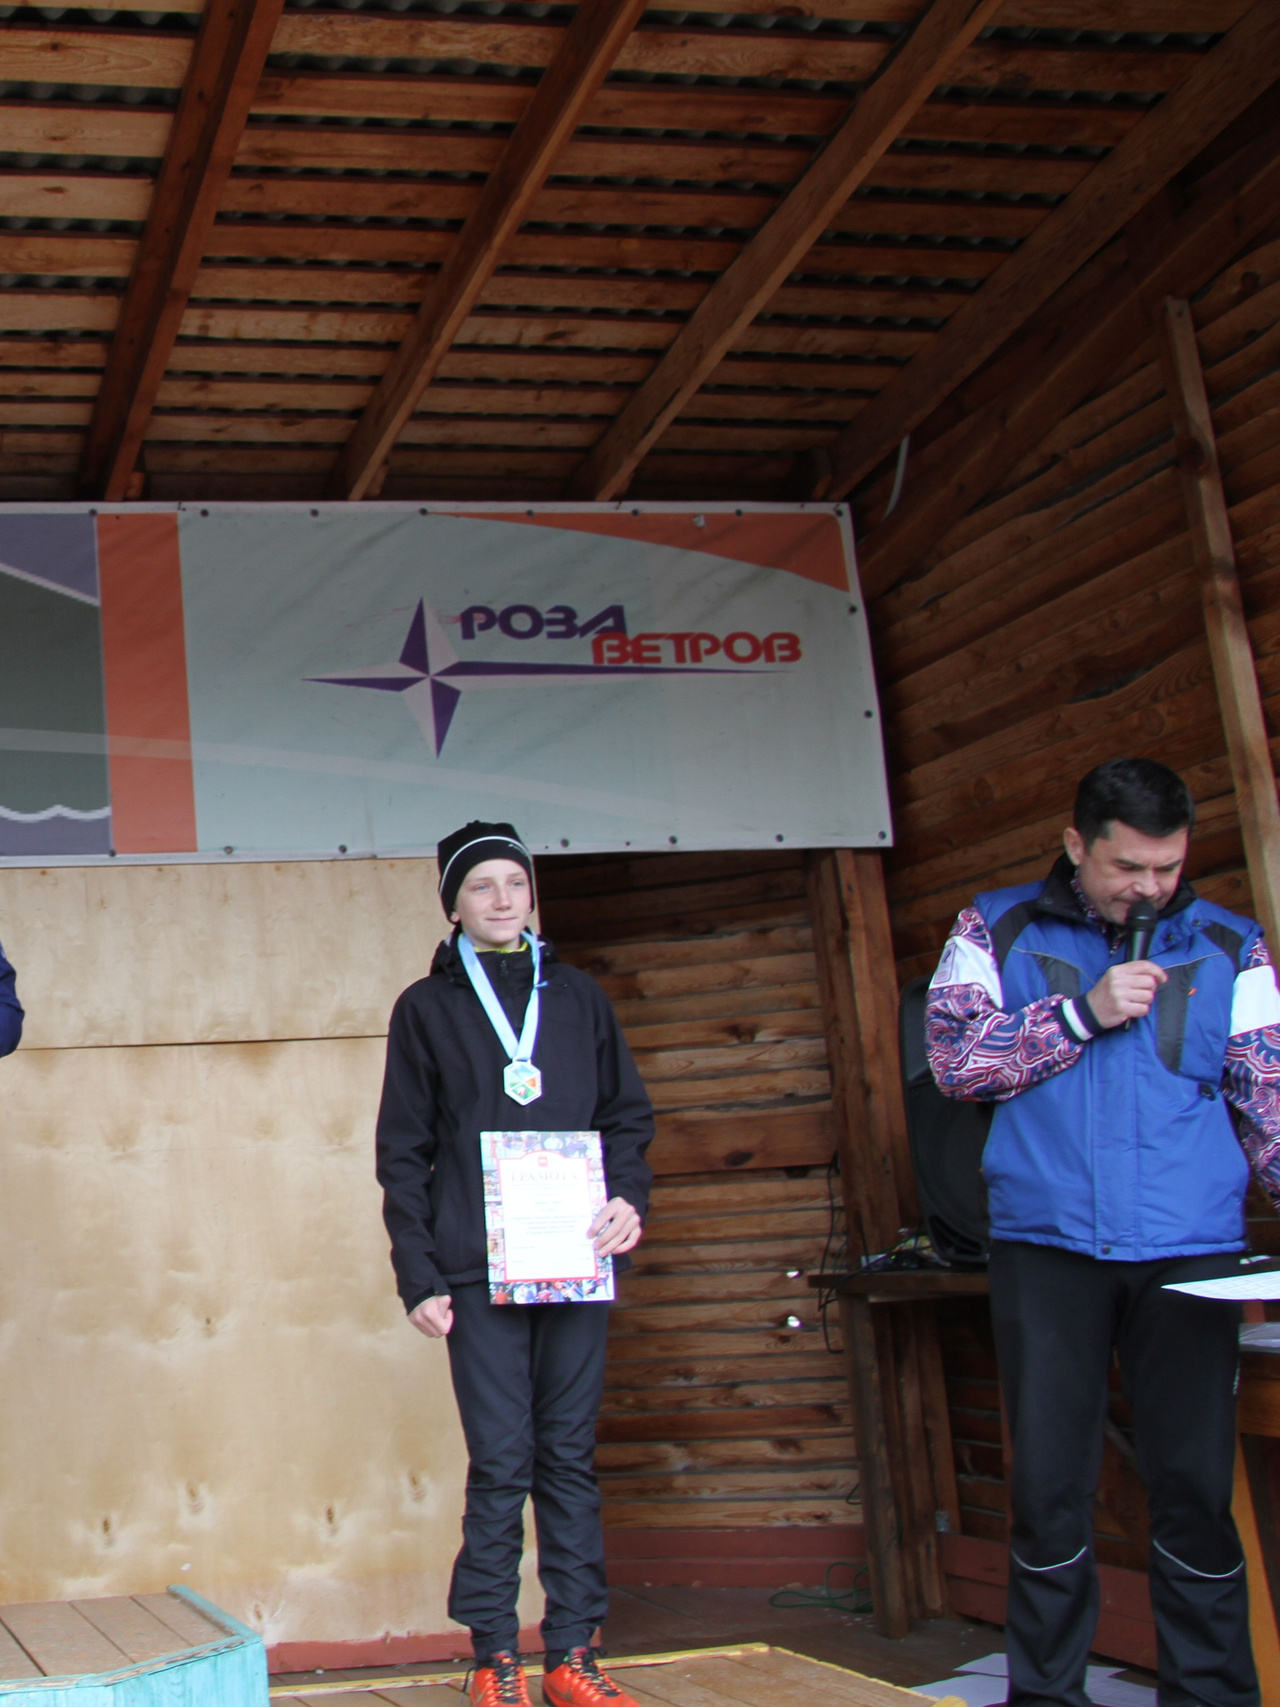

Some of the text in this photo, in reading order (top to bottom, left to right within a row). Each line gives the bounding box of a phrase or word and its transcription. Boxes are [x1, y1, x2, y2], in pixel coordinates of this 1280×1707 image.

[460, 604, 627, 640] РОЗА
[592, 632, 802, 665] ВЕТРОВ
[511, 1170, 578, 1182] ГРАМОТА
